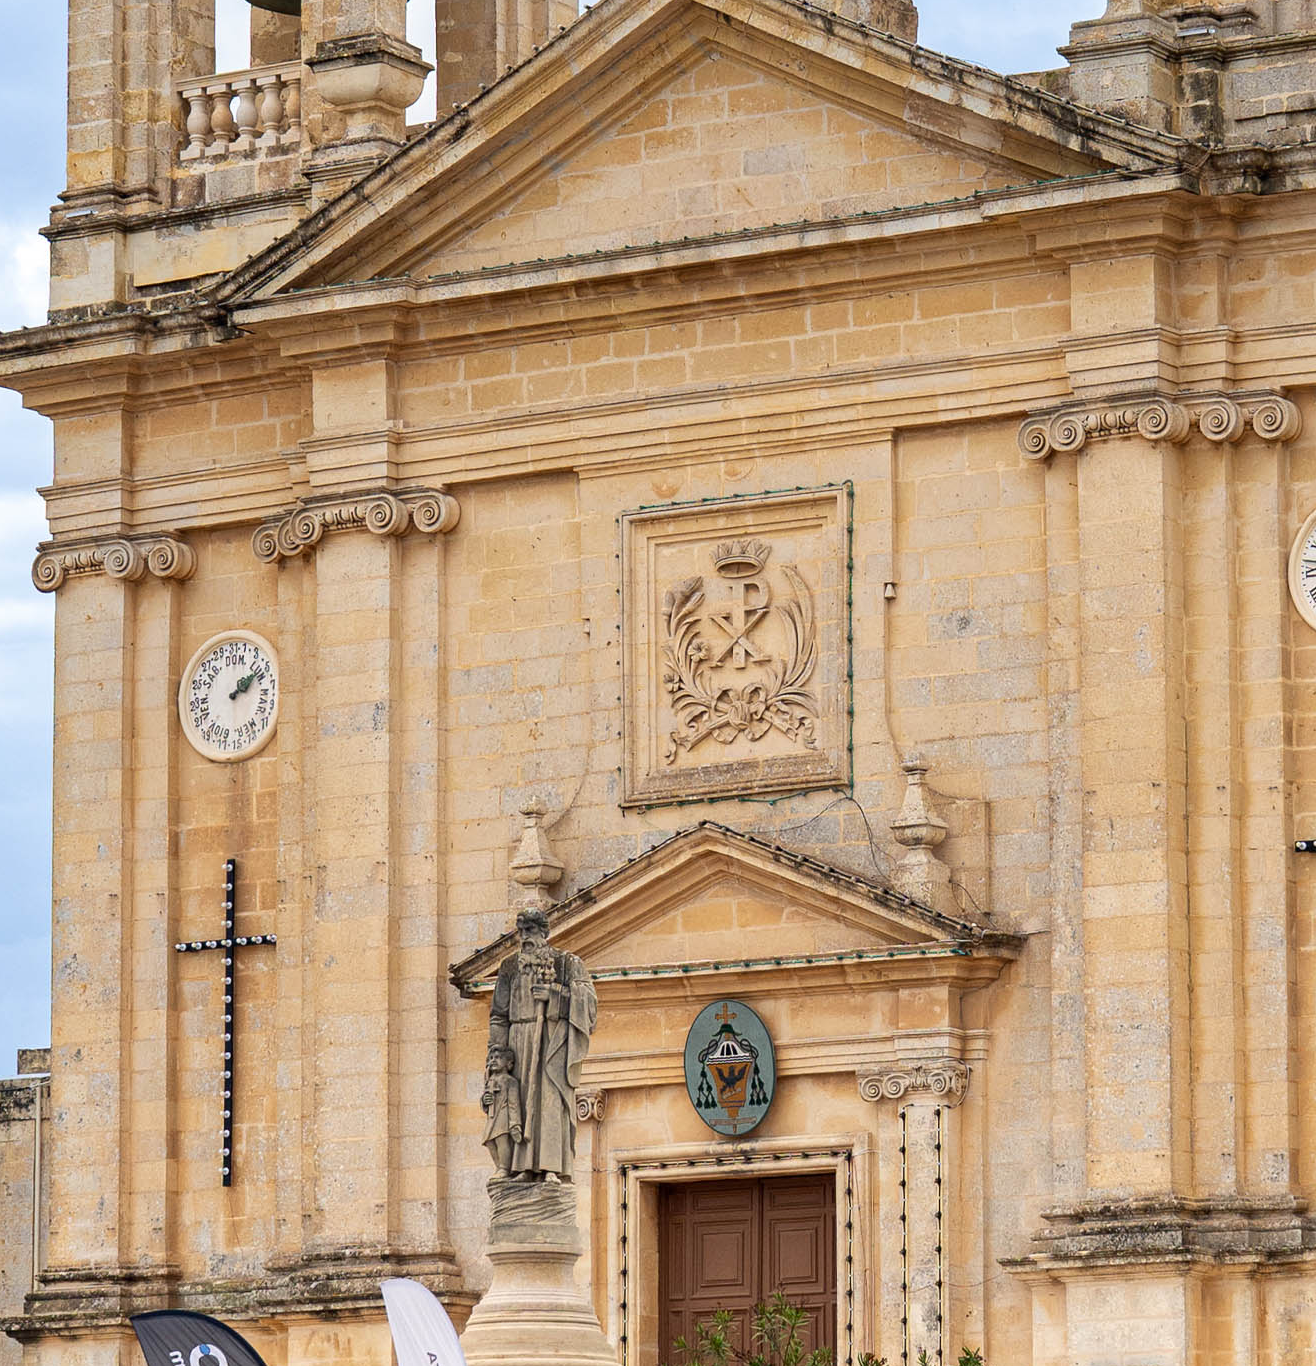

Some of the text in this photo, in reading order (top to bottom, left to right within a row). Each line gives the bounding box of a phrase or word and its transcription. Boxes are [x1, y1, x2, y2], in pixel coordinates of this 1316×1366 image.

[213, 647, 224, 661] 29
[229, 643, 238, 655] 31
[254, 647, 259, 659] 3
[201, 660, 212, 672] 27
[265, 661, 270, 673] 5
[192, 679, 203, 690] 25
[270, 679, 275, 690] 7
[190, 697, 199, 712] 23
